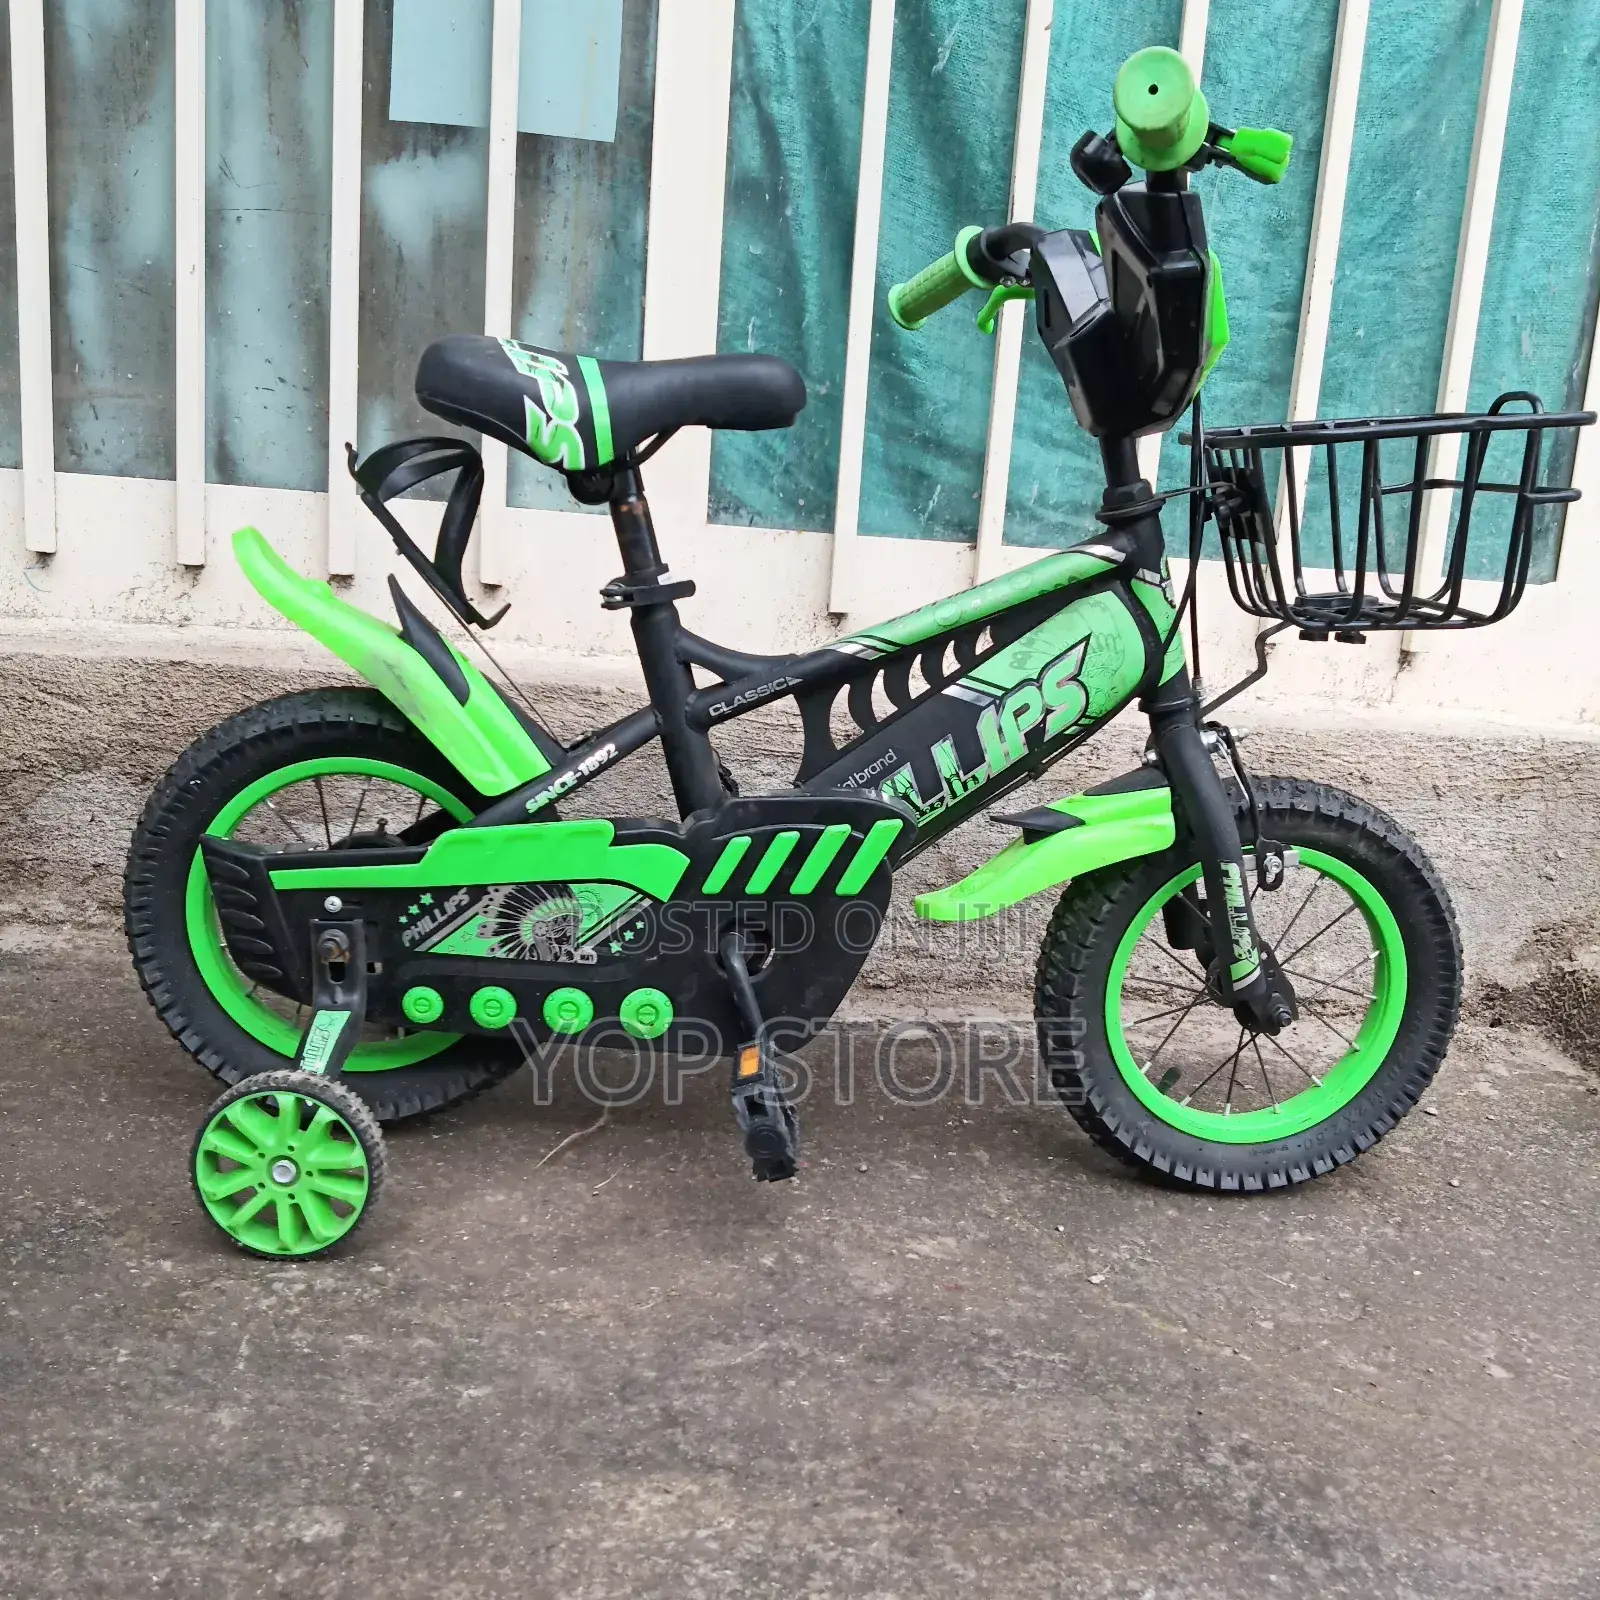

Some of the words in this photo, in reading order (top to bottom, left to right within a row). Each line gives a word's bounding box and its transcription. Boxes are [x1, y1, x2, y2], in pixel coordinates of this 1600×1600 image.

[709, 676, 788, 717] CLASSIC
[853, 748, 898, 784] brand
[401, 887, 471, 947] PHILLIPS
